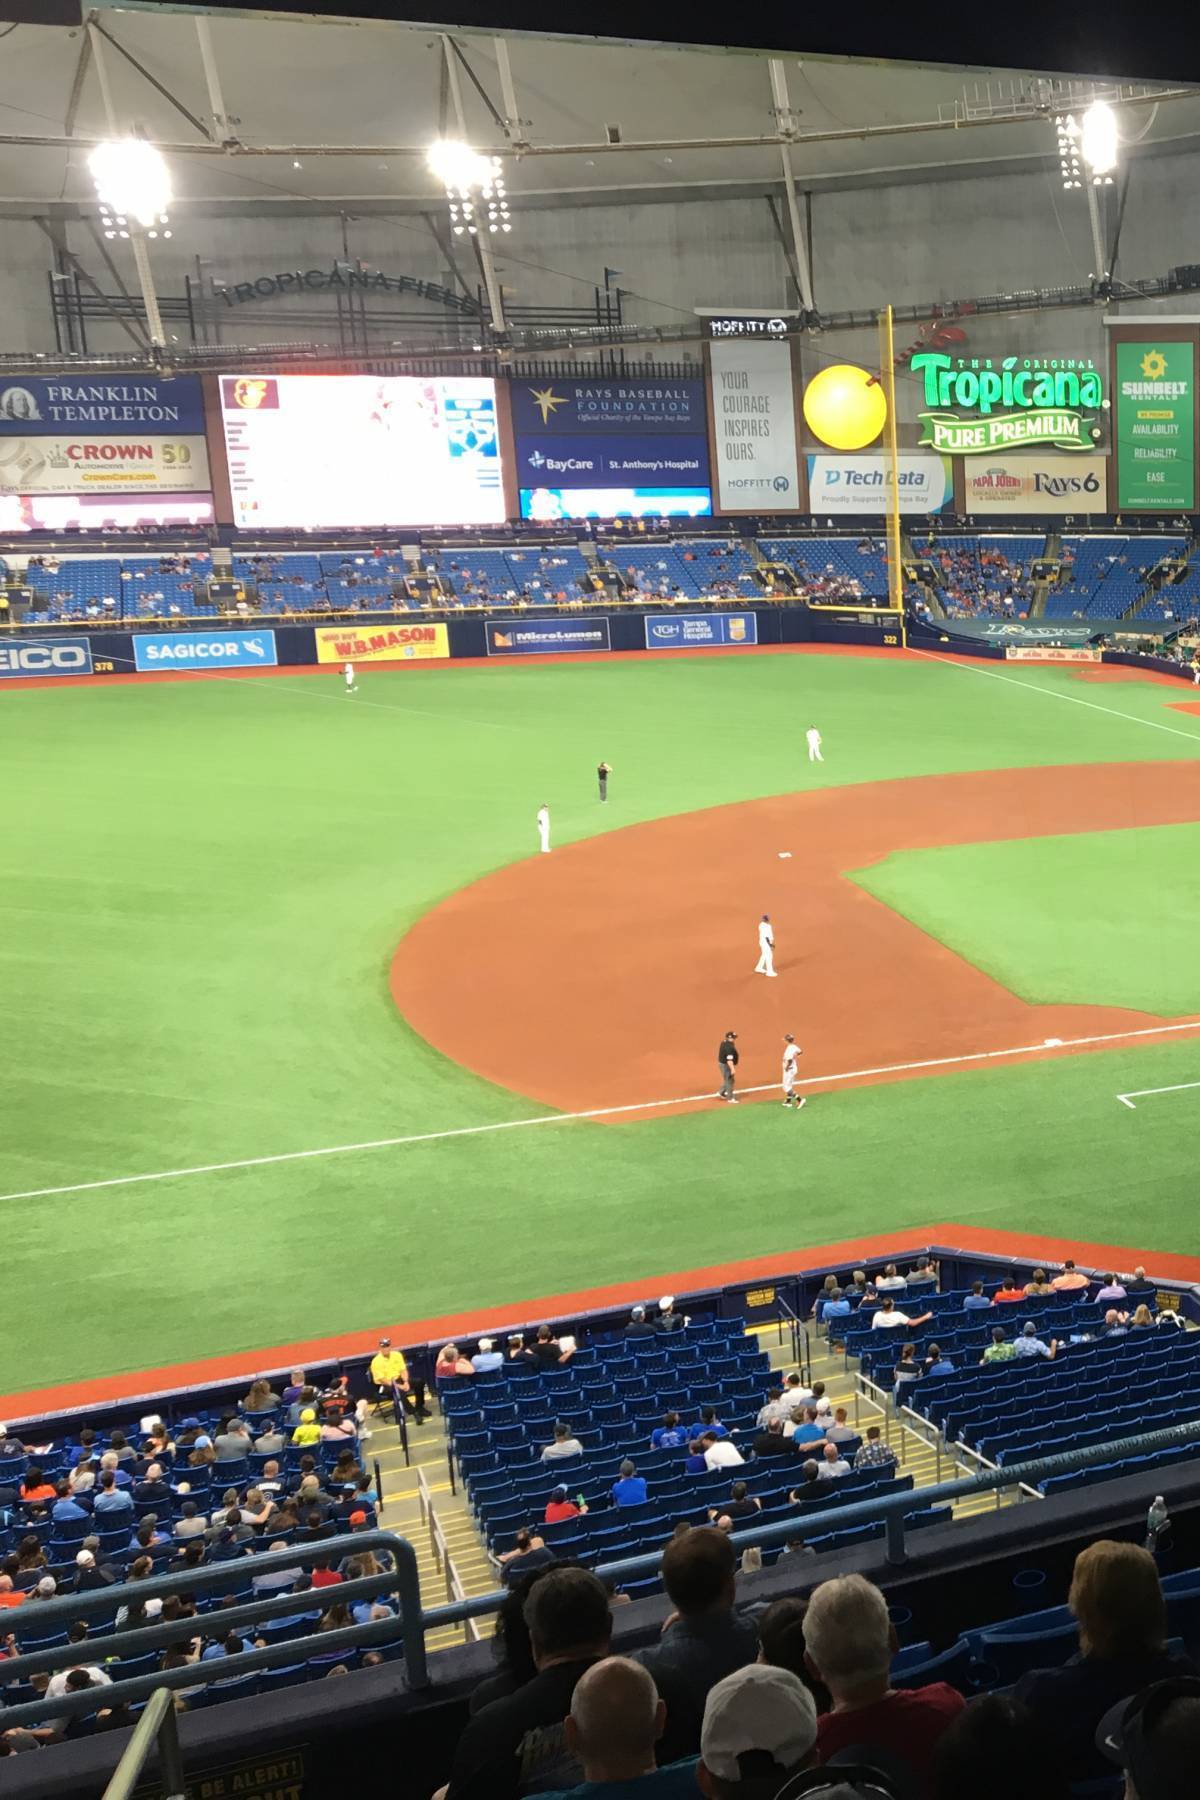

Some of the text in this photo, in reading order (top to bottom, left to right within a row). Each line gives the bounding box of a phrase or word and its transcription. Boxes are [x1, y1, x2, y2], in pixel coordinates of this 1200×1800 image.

[214, 269, 483, 316] TROPICANA FIELD
[711, 320, 766, 332] MOFFITT
[957, 359, 1094, 369] THE ORIGINAL
[721, 371, 749, 390] YOUR
[911, 352, 1103, 413] Tropicana
[48, 386, 158, 402] FRANKLIN
[575, 388, 690, 399] RAYS BASEBALL
[1122, 381, 1188, 395] SUNBELT
[577, 401, 690, 411] FOUNDATION
[722, 395, 771, 413] COURAGE
[49, 406, 179, 422] TEMPLETON
[724, 419, 770, 437] INSPIRES
[934, 415, 1080, 448] PURE PREMIUM
[1132, 424, 1179, 434] AVAILABILITY
[66, 443, 191, 464] CROWN 50
[726, 443, 757, 460] OURS.
[1134, 448, 1177, 458] RELIABILITY
[546, 458, 594, 472] BayCare
[609, 461, 621, 469] St.
[664, 460, 699, 470] Hospital
[727, 479, 772, 488] MOFFITT
[843, 470, 884, 485] Tech
[973, 475, 993, 488] PAPA
[1146, 472, 1165, 482] EASE
[516, 630, 602, 640] MicroLumen
[658, 624, 680, 634] TGH
[883, 634, 897, 645] 322
[145, 641, 239, 660] SAGICOR
[95, 661, 114, 672] 378
[200, 1780, 225, 1798] BE
[232, 1760, 298, 1791] ALERT!
